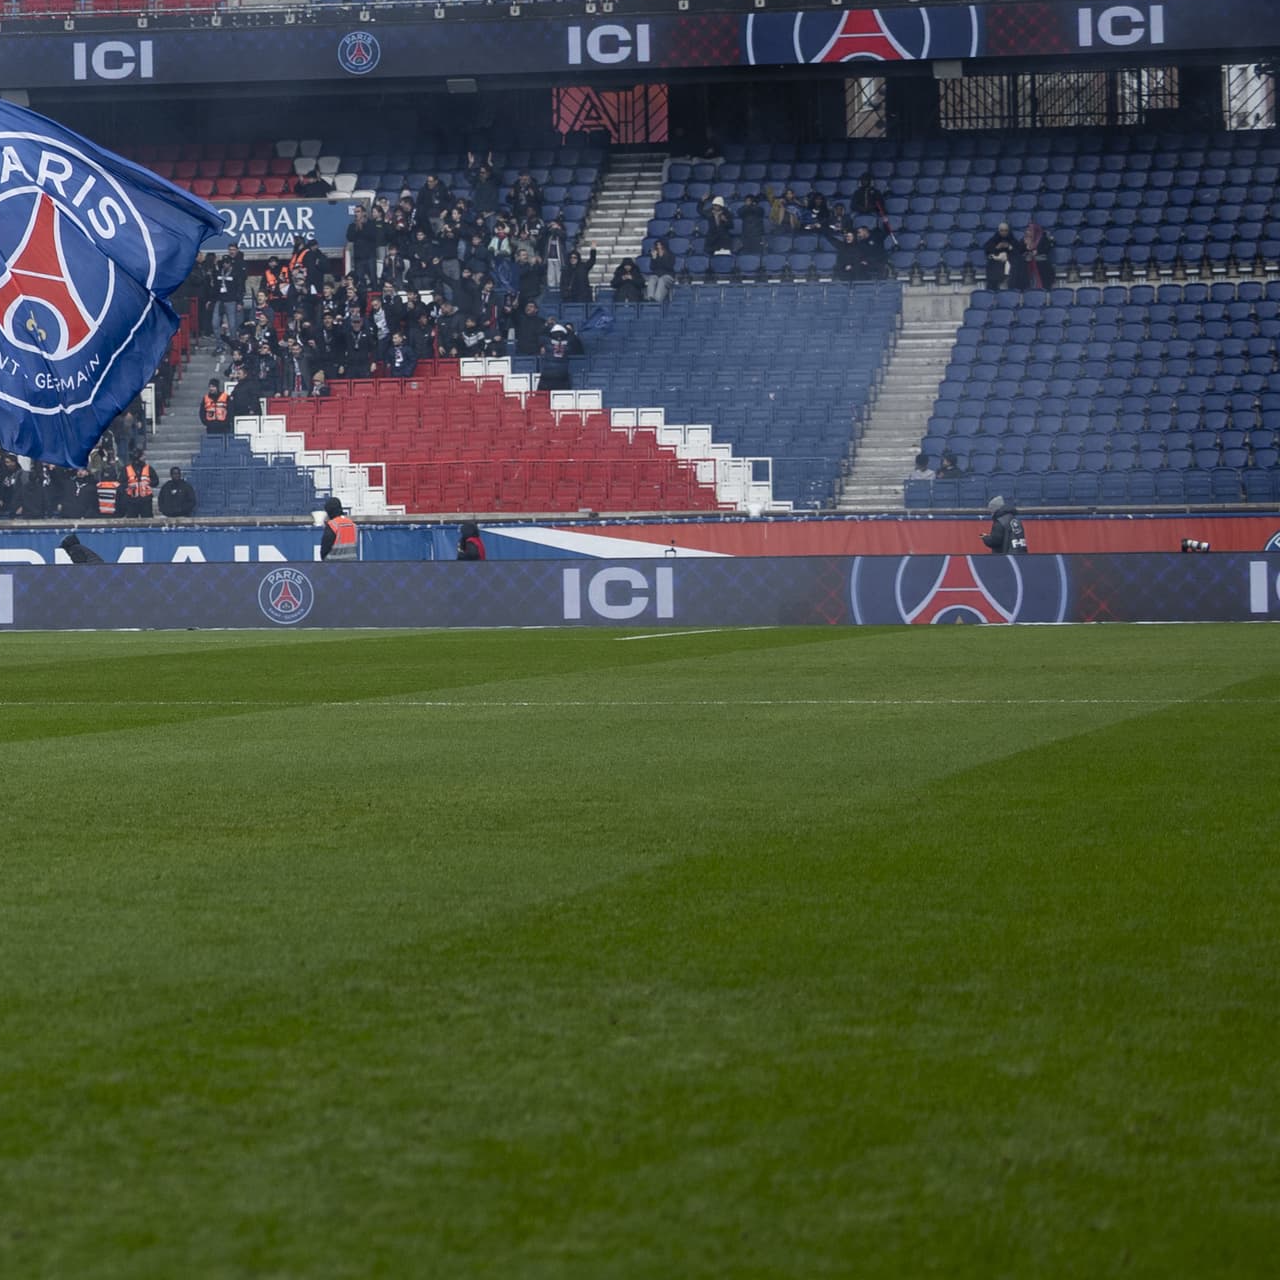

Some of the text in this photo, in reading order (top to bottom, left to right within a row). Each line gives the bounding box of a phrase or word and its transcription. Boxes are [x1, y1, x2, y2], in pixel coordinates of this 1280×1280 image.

[568, 24, 650, 64] ICI
[1078, 6, 1165, 45] ICI
[73, 40, 153, 80] ICI
[218, 207, 315, 237] QATAR
[268, 570, 304, 584] PARIS
[563, 567, 675, 620] ICI
